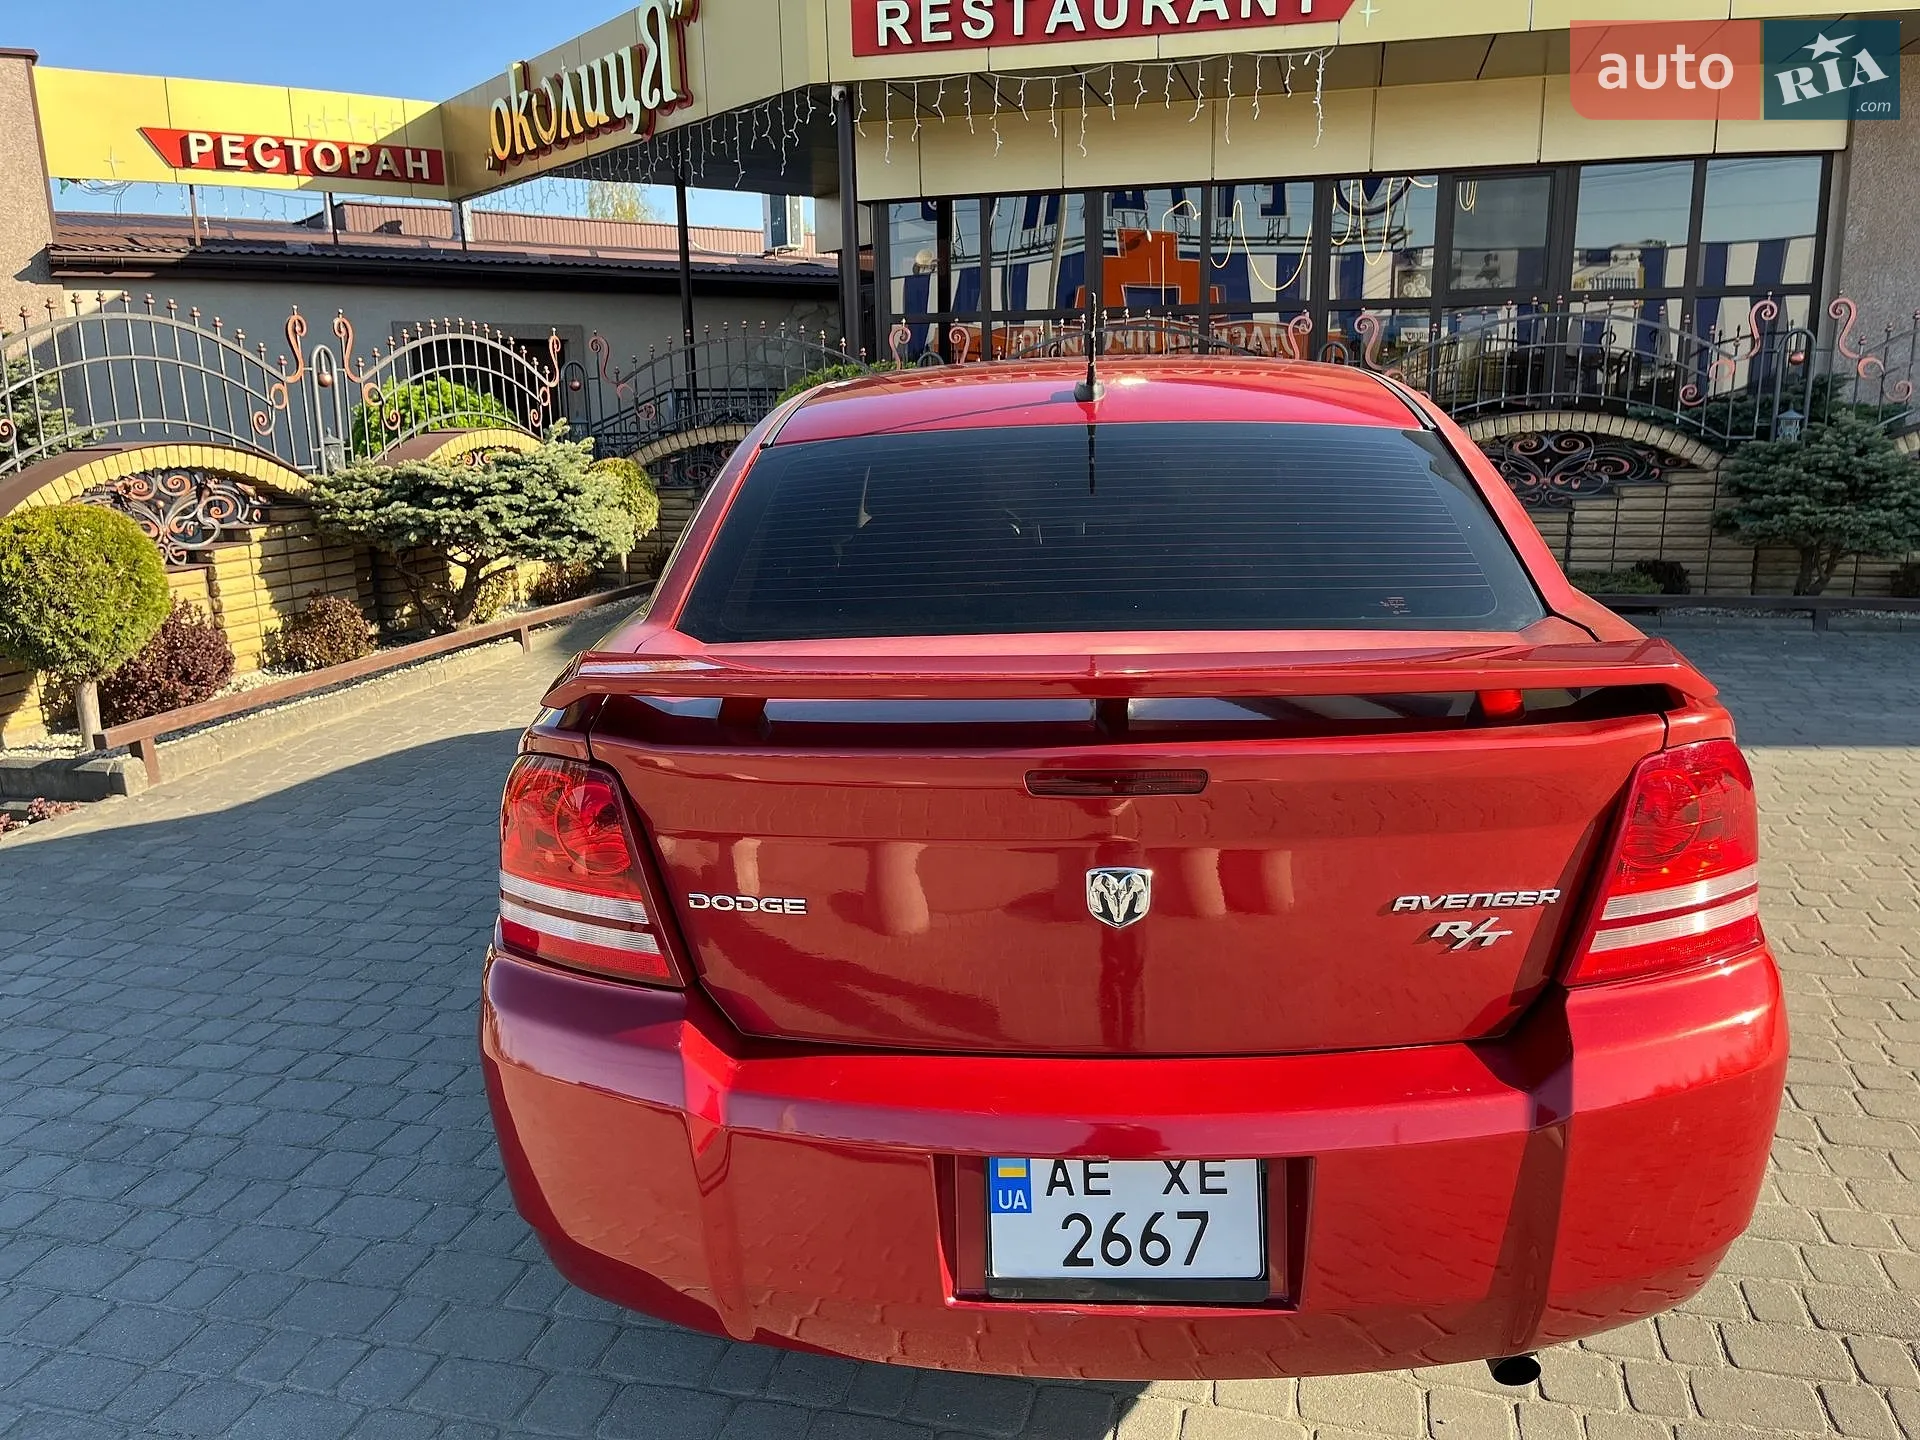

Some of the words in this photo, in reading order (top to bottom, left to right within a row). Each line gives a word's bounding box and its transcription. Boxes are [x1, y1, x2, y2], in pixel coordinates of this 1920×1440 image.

[188, 132, 430, 179] РЕСТОРАН
[688, 893, 807, 915] DODGE
[1393, 889, 1560, 912] AVENGER
[1431, 917, 1513, 950] R/T
[1046, 1159, 1111, 1196] AE
[1162, 1159, 1228, 1195] XE
[998, 1190, 1028, 1210] UA
[1061, 1211, 1209, 1267] 2667
